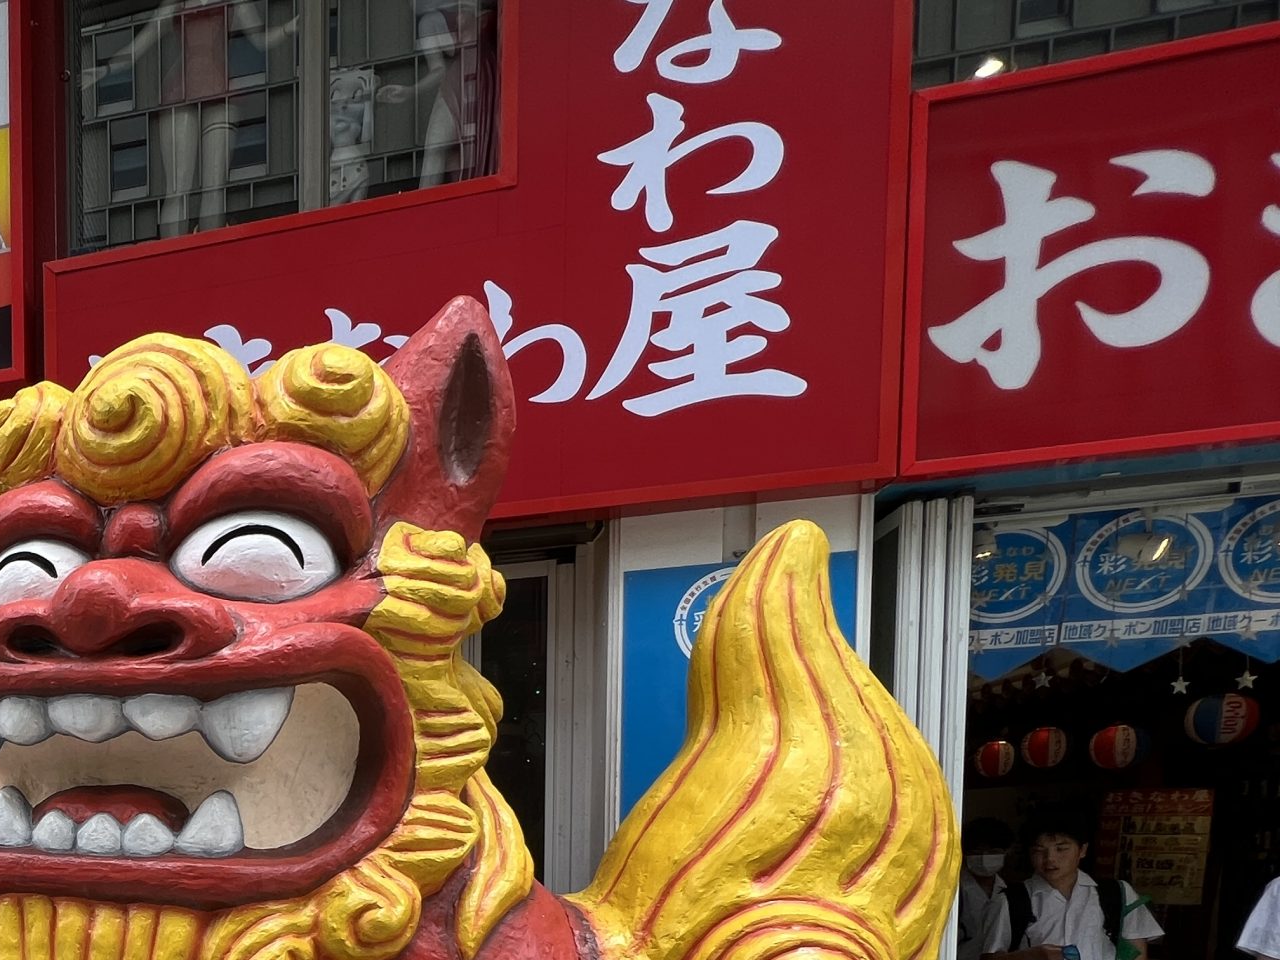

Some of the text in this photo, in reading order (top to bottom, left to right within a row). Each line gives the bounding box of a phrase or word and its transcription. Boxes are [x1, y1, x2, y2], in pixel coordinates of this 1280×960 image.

[928, 148, 1280, 390] お
[1064, 618, 1201, 640] 地域クーポン加盟店
